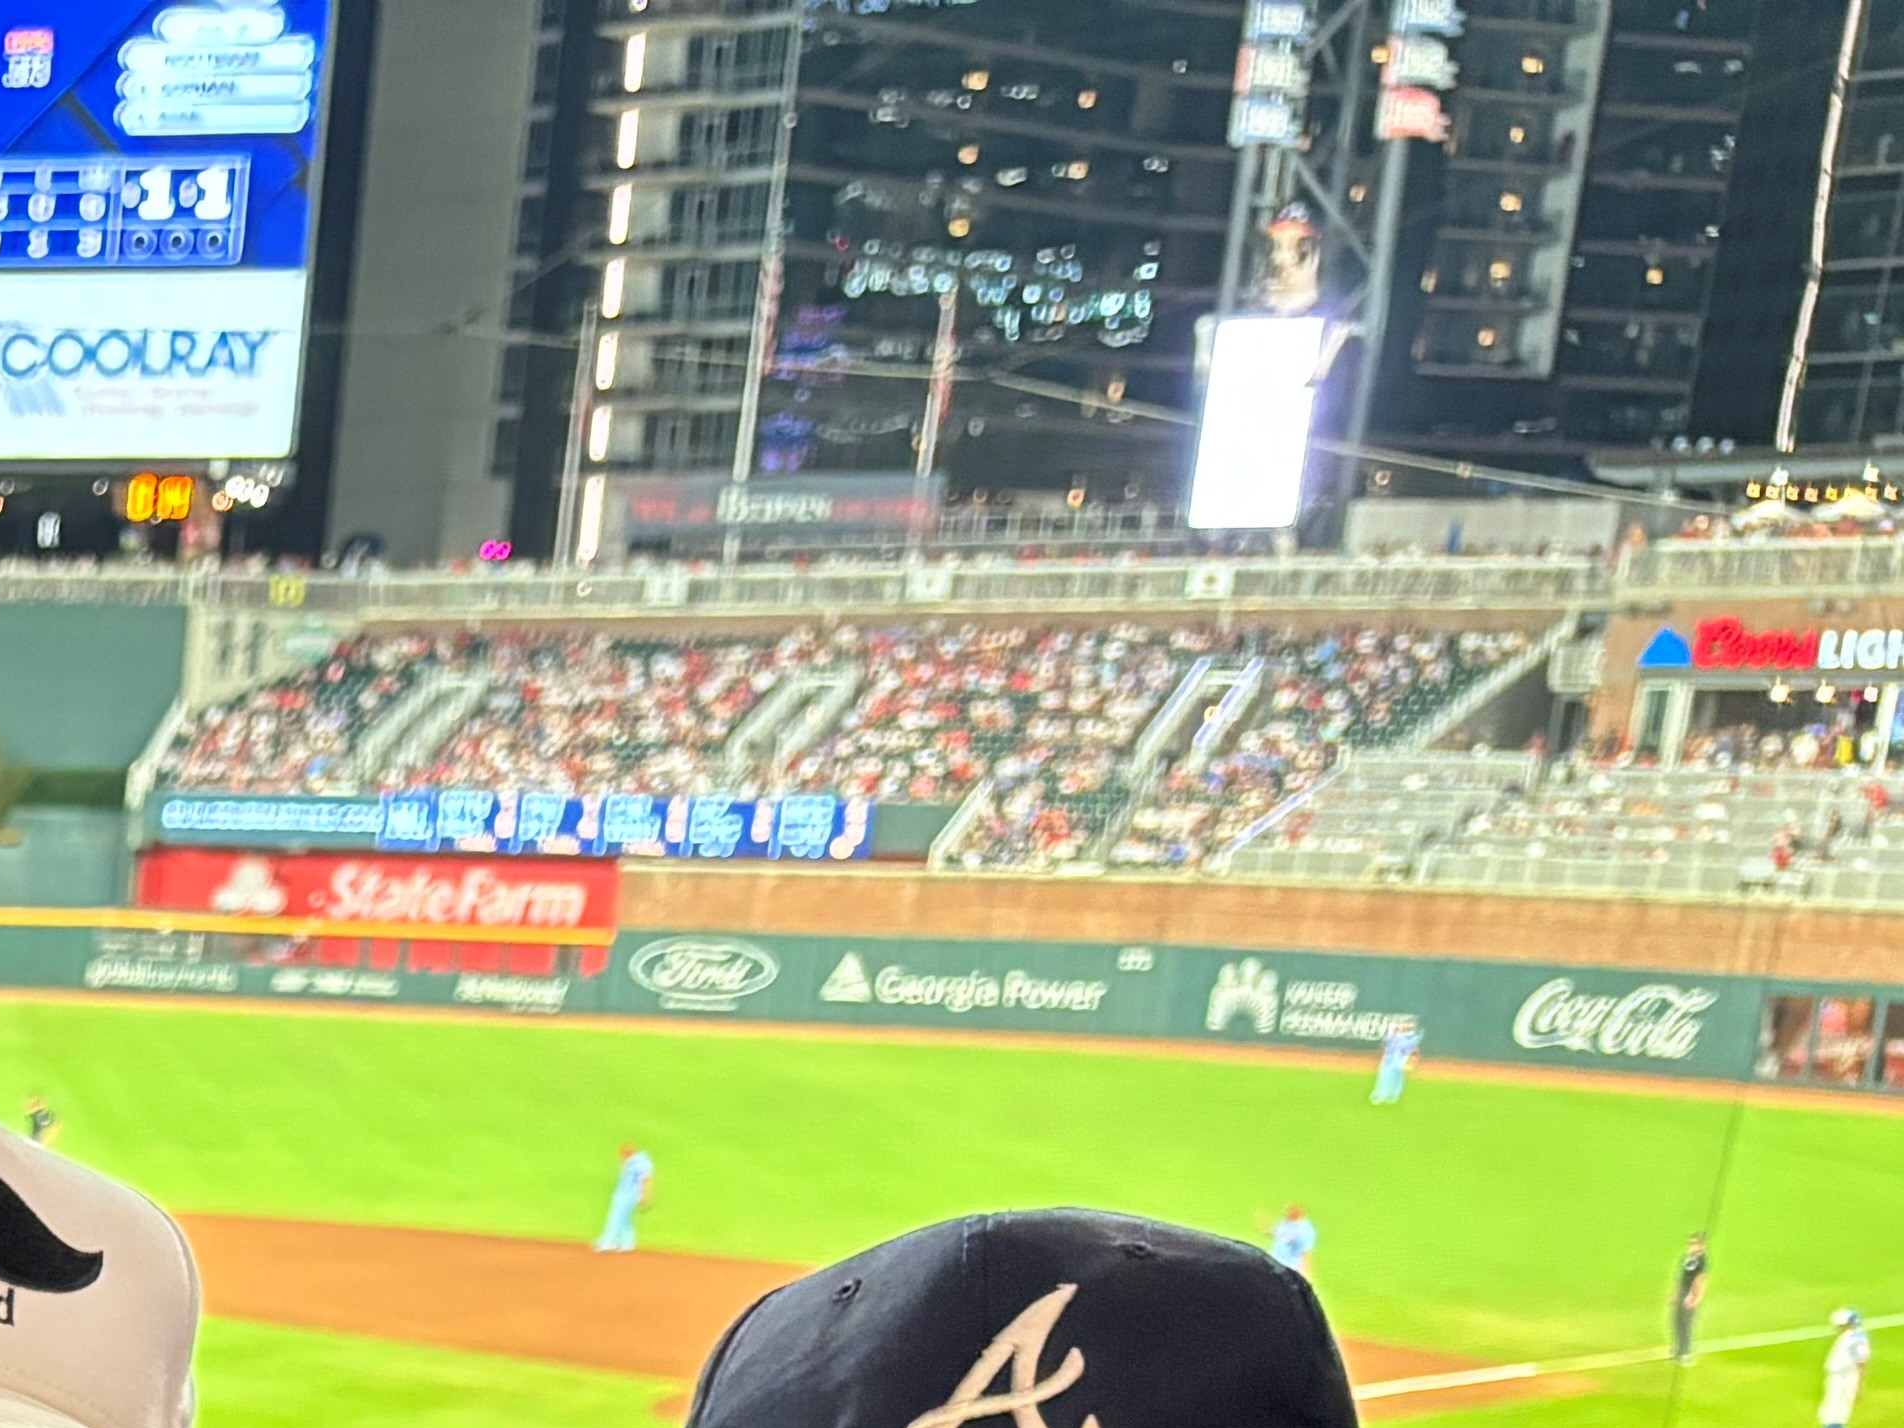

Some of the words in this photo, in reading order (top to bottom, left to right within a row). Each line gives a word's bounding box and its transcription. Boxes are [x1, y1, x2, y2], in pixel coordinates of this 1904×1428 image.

[1, 329, 271, 378] COOLRAY
[657, 946, 760, 996] Ford
[874, 968, 998, 1011] Georgia
[1001, 976, 1107, 1013] Power
